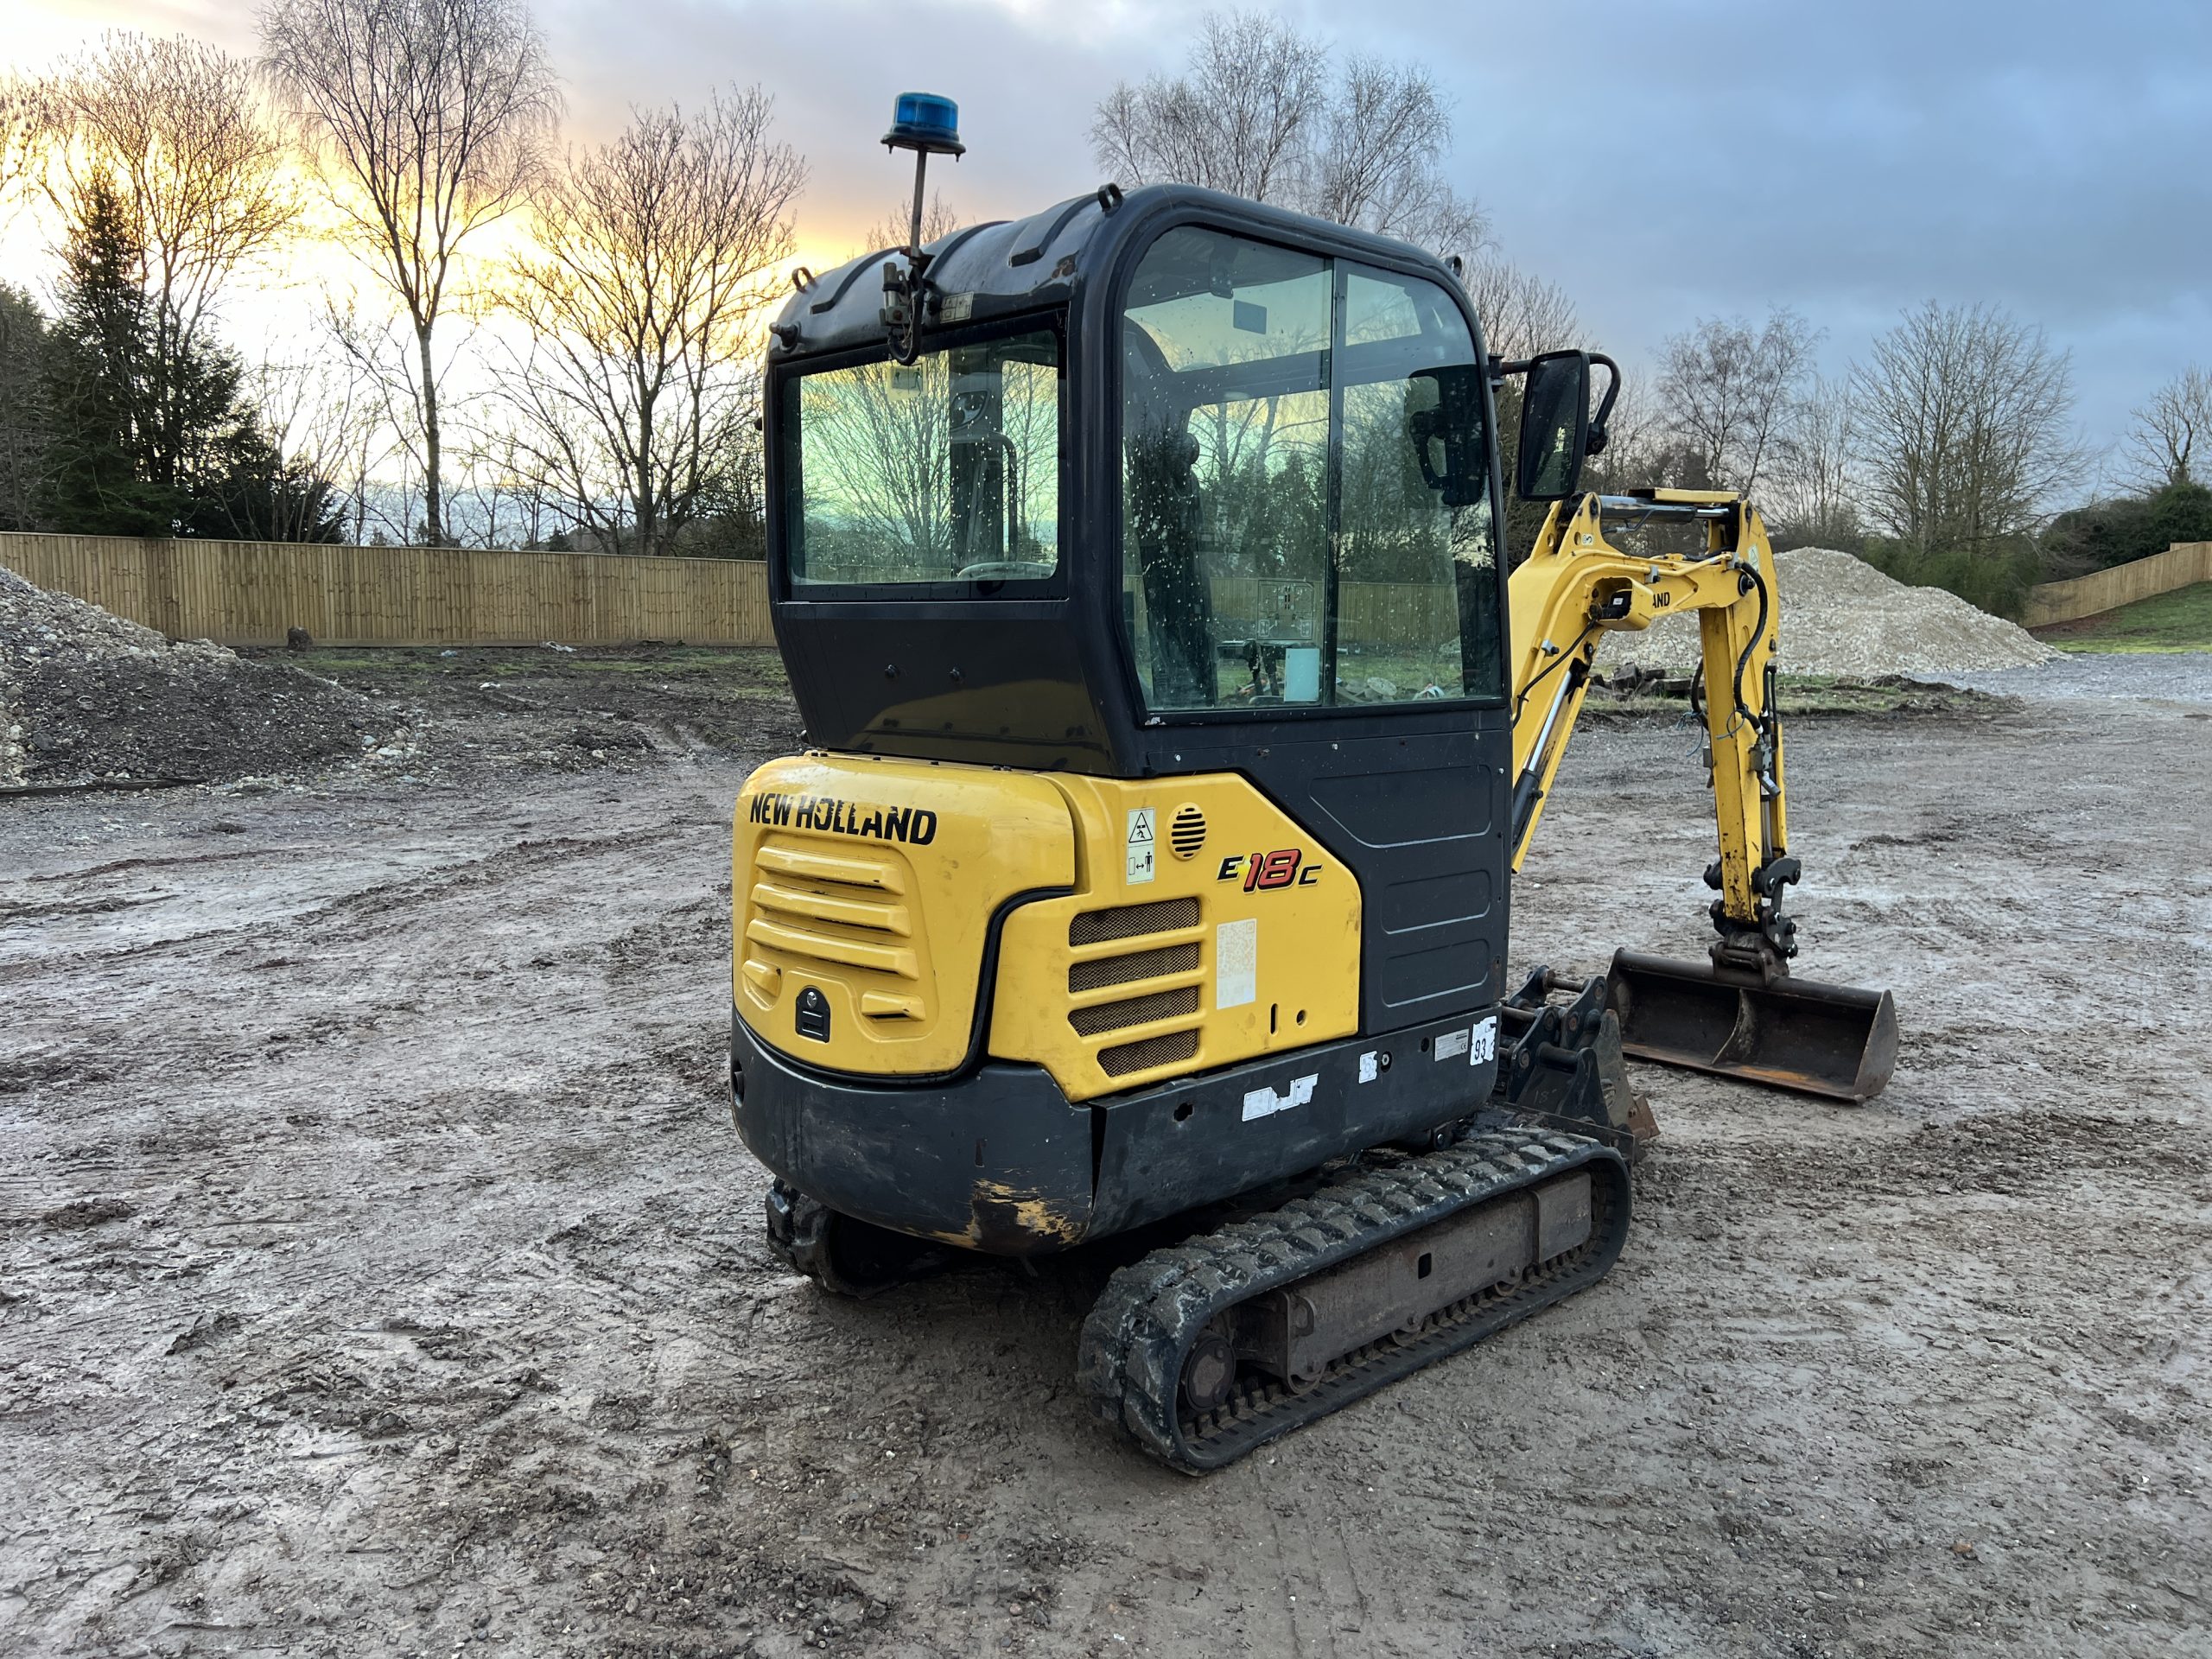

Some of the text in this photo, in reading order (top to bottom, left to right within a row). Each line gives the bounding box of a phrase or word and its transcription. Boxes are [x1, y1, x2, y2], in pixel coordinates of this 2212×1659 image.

[750, 792, 937, 845] NEW HOLLAND
[1474, 1038, 1486, 1061] 93
